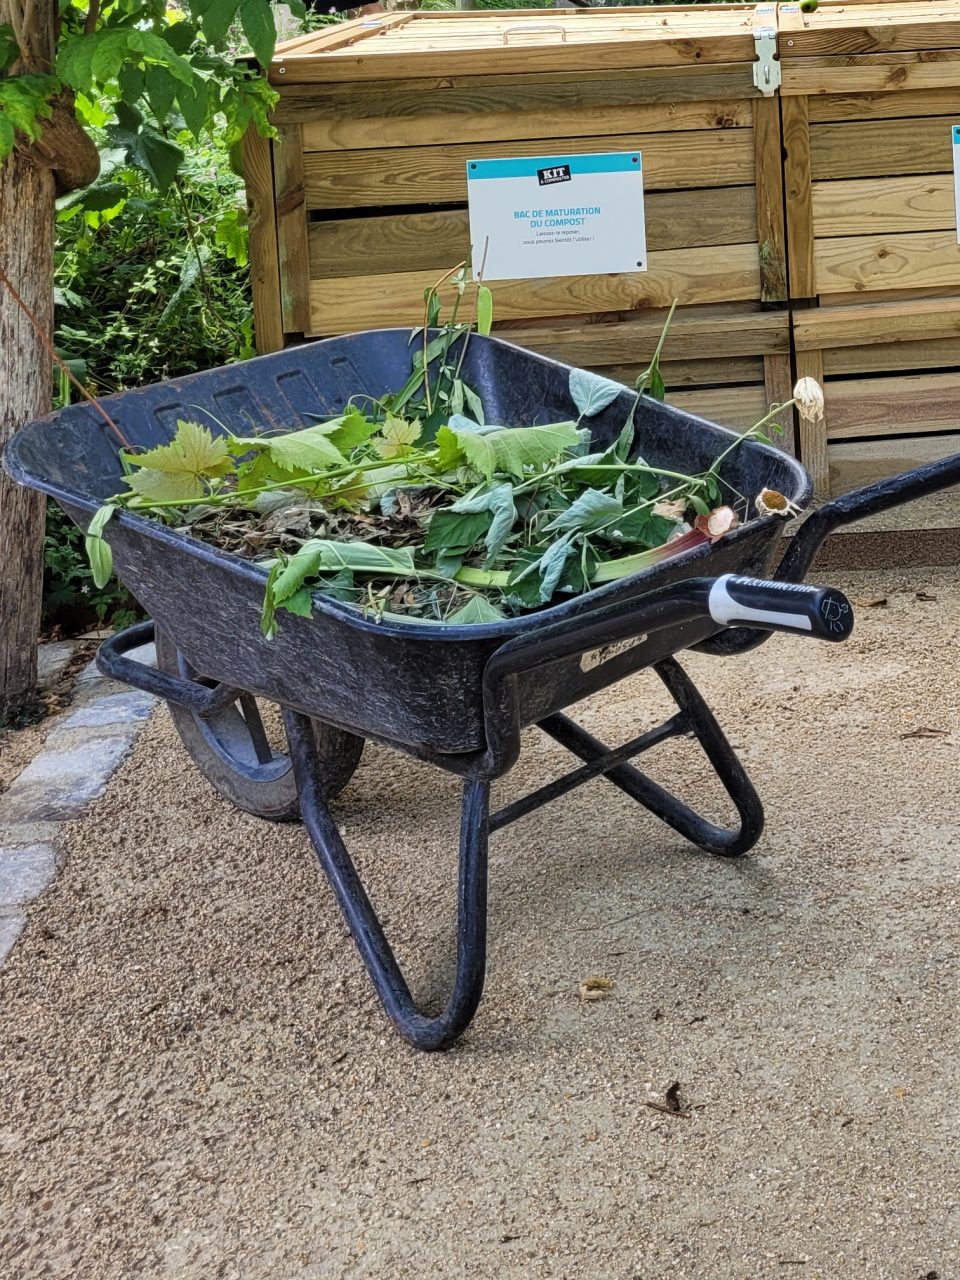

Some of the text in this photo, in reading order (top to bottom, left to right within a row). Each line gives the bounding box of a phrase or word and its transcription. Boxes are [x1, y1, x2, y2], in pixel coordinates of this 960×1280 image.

[542, 167, 565, 179] KIT
[514, 207, 601, 219] BAC DE MATURATION
[530, 217, 586, 228] DU COMPOST
